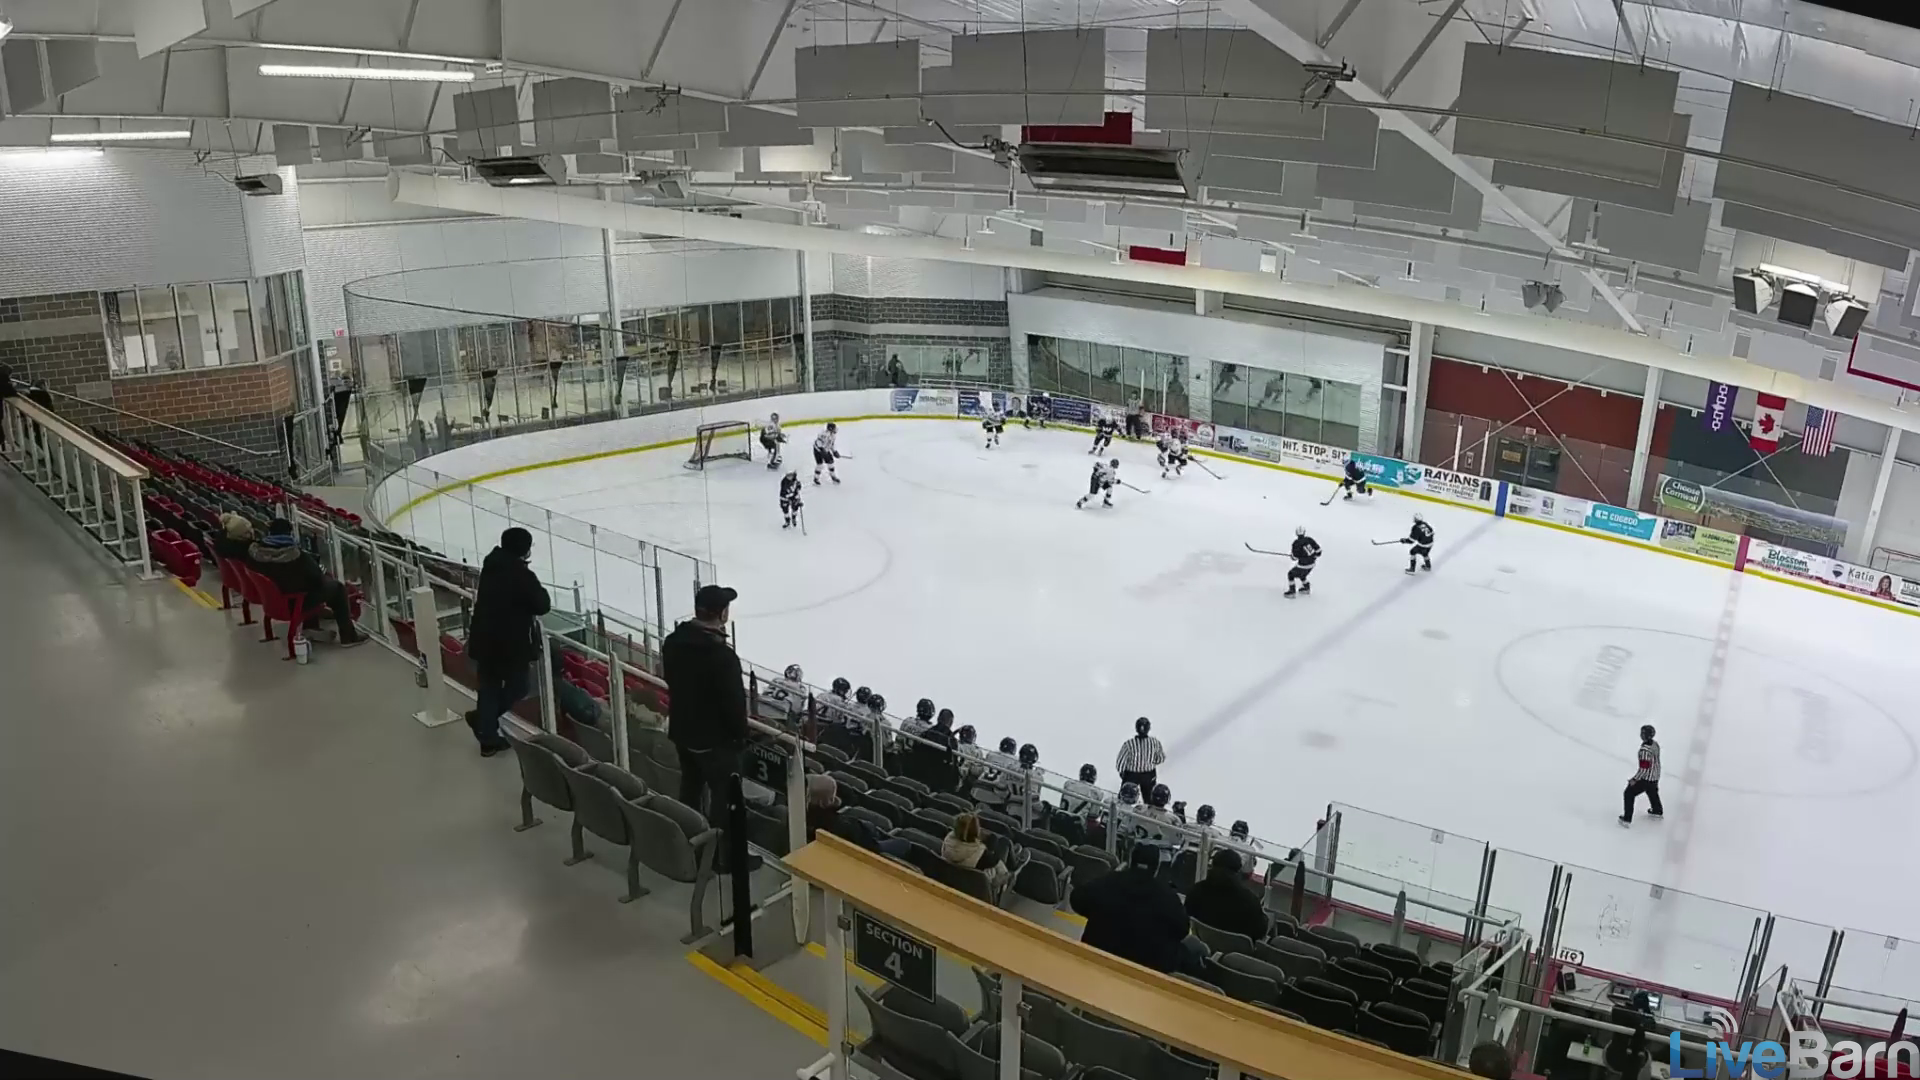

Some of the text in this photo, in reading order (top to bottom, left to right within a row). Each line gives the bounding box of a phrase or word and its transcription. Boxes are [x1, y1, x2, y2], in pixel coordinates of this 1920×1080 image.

[1282, 440, 1299, 452] HIT.
[1301, 443, 1329, 458] STOP.
[1424, 468, 1480, 488] RAYJANS
[1665, 487, 1699, 503] Cornwall
[1672, 481, 1701, 496] Choose
[1767, 548, 1808, 568] Blossom
[1847, 566, 1875, 583] Katie
[756, 760, 769, 781] 3
[865, 923, 923, 959] SECTION
[884, 951, 904, 979] 4
